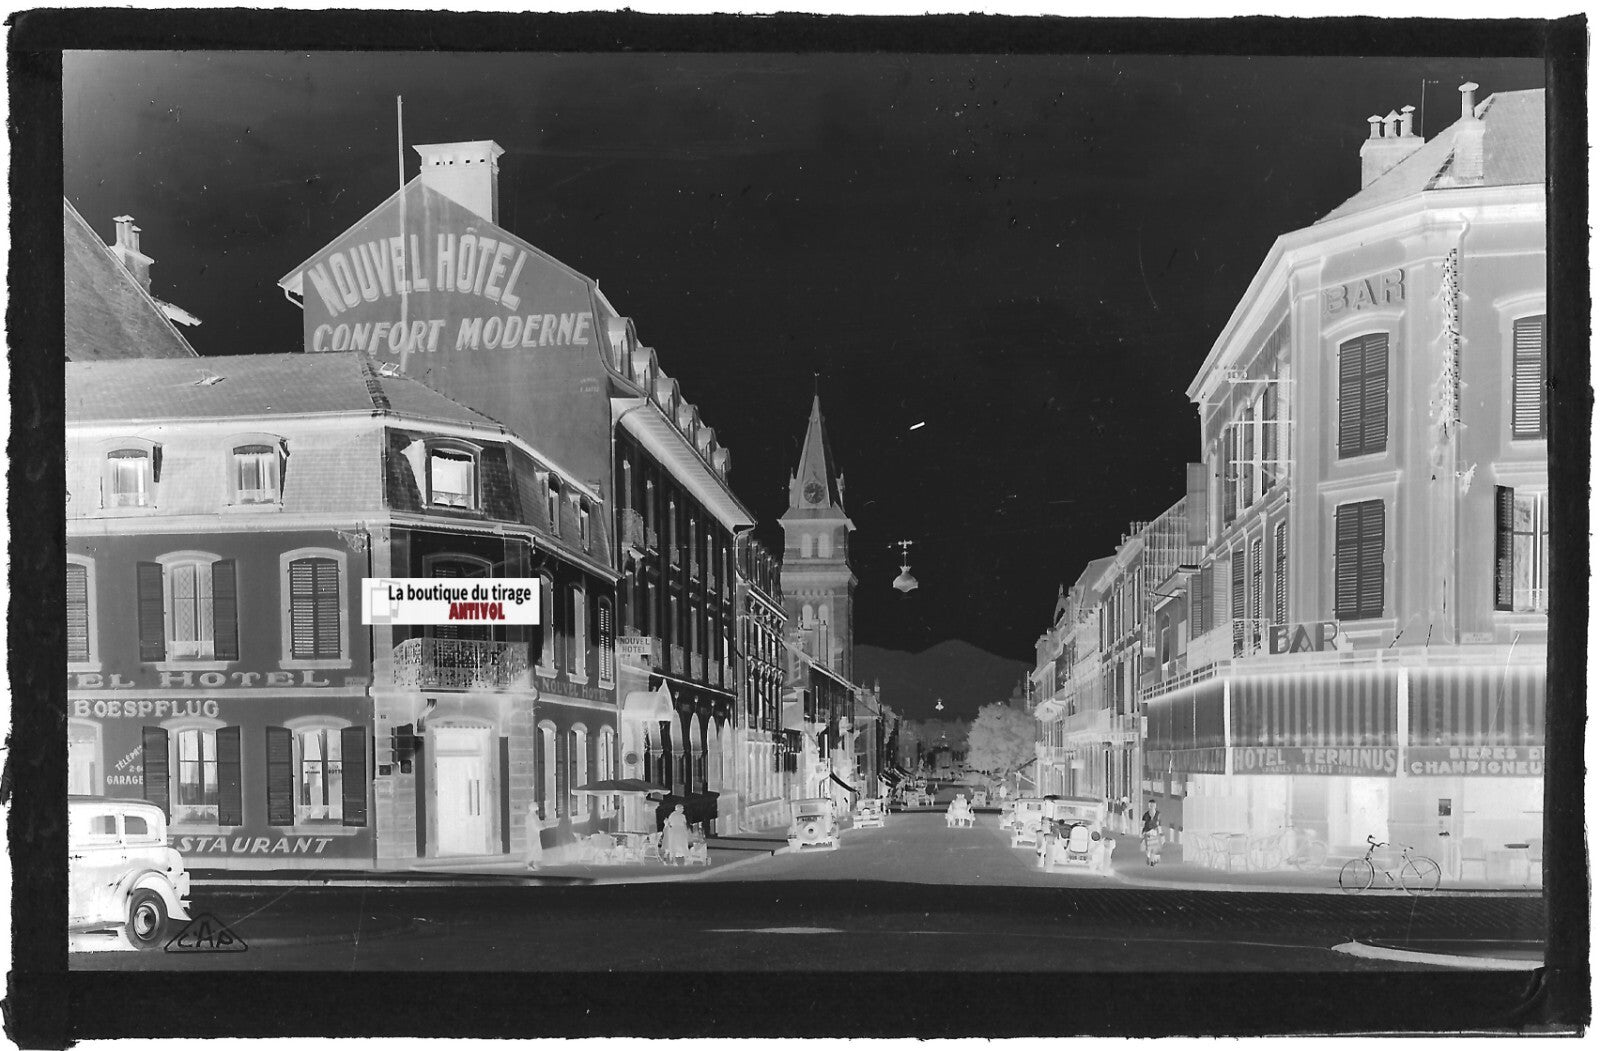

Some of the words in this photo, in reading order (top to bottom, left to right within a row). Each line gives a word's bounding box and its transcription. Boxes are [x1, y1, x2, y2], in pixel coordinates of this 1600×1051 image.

[308, 233, 430, 317] NOUVEL
[436, 226, 529, 311] HÔTEL
[1321, 268, 1406, 313] BAR
[312, 319, 447, 355] CONFORT
[455, 312, 593, 351] MODERNE
[619, 637, 650, 646] NOUVEL
[1269, 621, 1338, 655] BAR
[67, 673, 136, 688] EL
[159, 670, 331, 688] HOTEL
[542, 678, 579, 698] NOUVEL
[74, 699, 220, 718] BOESPFLUG
[1234, 749, 1286, 772] HOTEL
[1302, 748, 1397, 774] TERMINUS
[1529, 748, 1545, 760] D
[1411, 761, 1543, 775] CHAMPIGNEU
[106, 774, 144, 785] GARAGE
